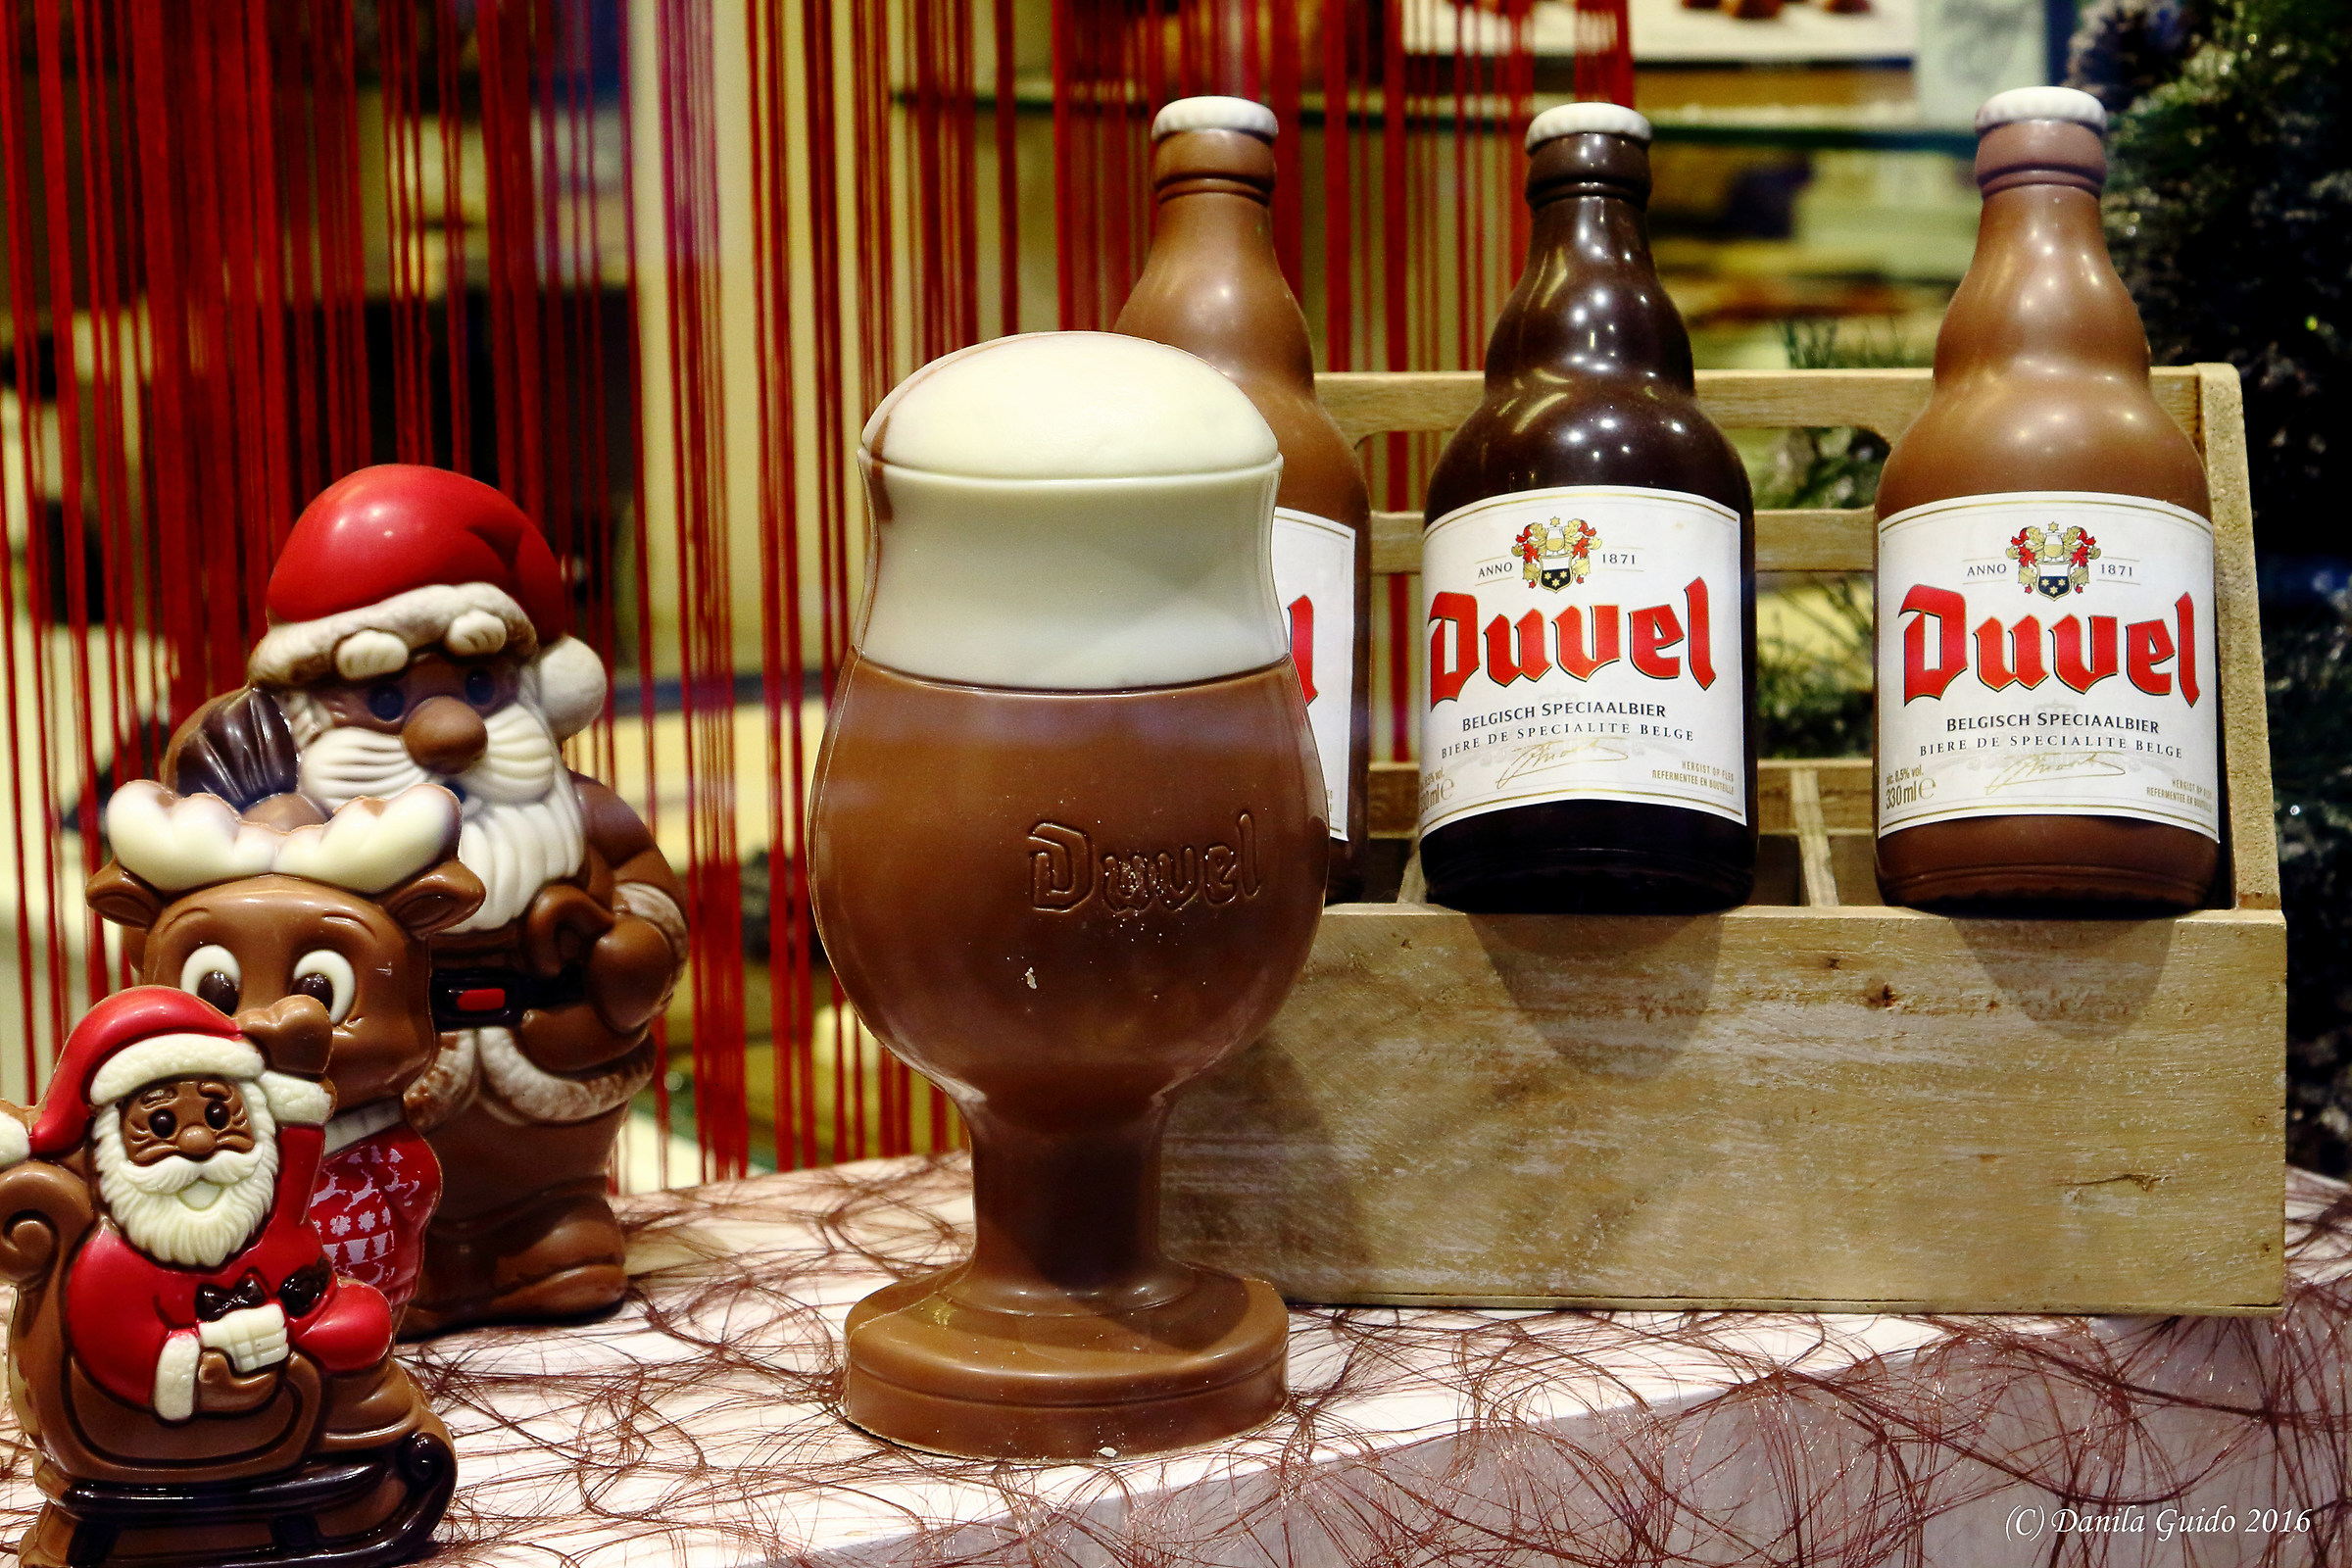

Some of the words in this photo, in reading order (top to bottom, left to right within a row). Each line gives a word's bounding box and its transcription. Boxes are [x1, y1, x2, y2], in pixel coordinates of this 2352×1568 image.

[1478, 563, 1513, 578] ANNO
[1601, 554, 1637, 565] 1871
[1967, 564, 2007, 576] ANNO
[2100, 564, 2133, 577] 1871
[1428, 576, 1717, 712] Duvel
[1898, 584, 2201, 709] Duvel
[1462, 706, 1536, 732] BELGISCH
[1542, 702, 1667, 717] SPECIAALBIER
[1946, 714, 2031, 732] BELGISCH
[2037, 712, 2159, 734] SPECIAALBIER
[1442, 738, 1481, 760] BIERE
[1489, 731, 1509, 745] DE
[1517, 722, 1631, 740] SPECIALITE
[1641, 723, 1693, 742] BELGE
[1920, 740, 1967, 758] BIERE
[1977, 737, 2000, 749] DE
[2010, 735, 2127, 749] SPECIALITE
[2136, 741, 2182, 759] BELGE
[1027, 808, 1262, 914] Duvel
